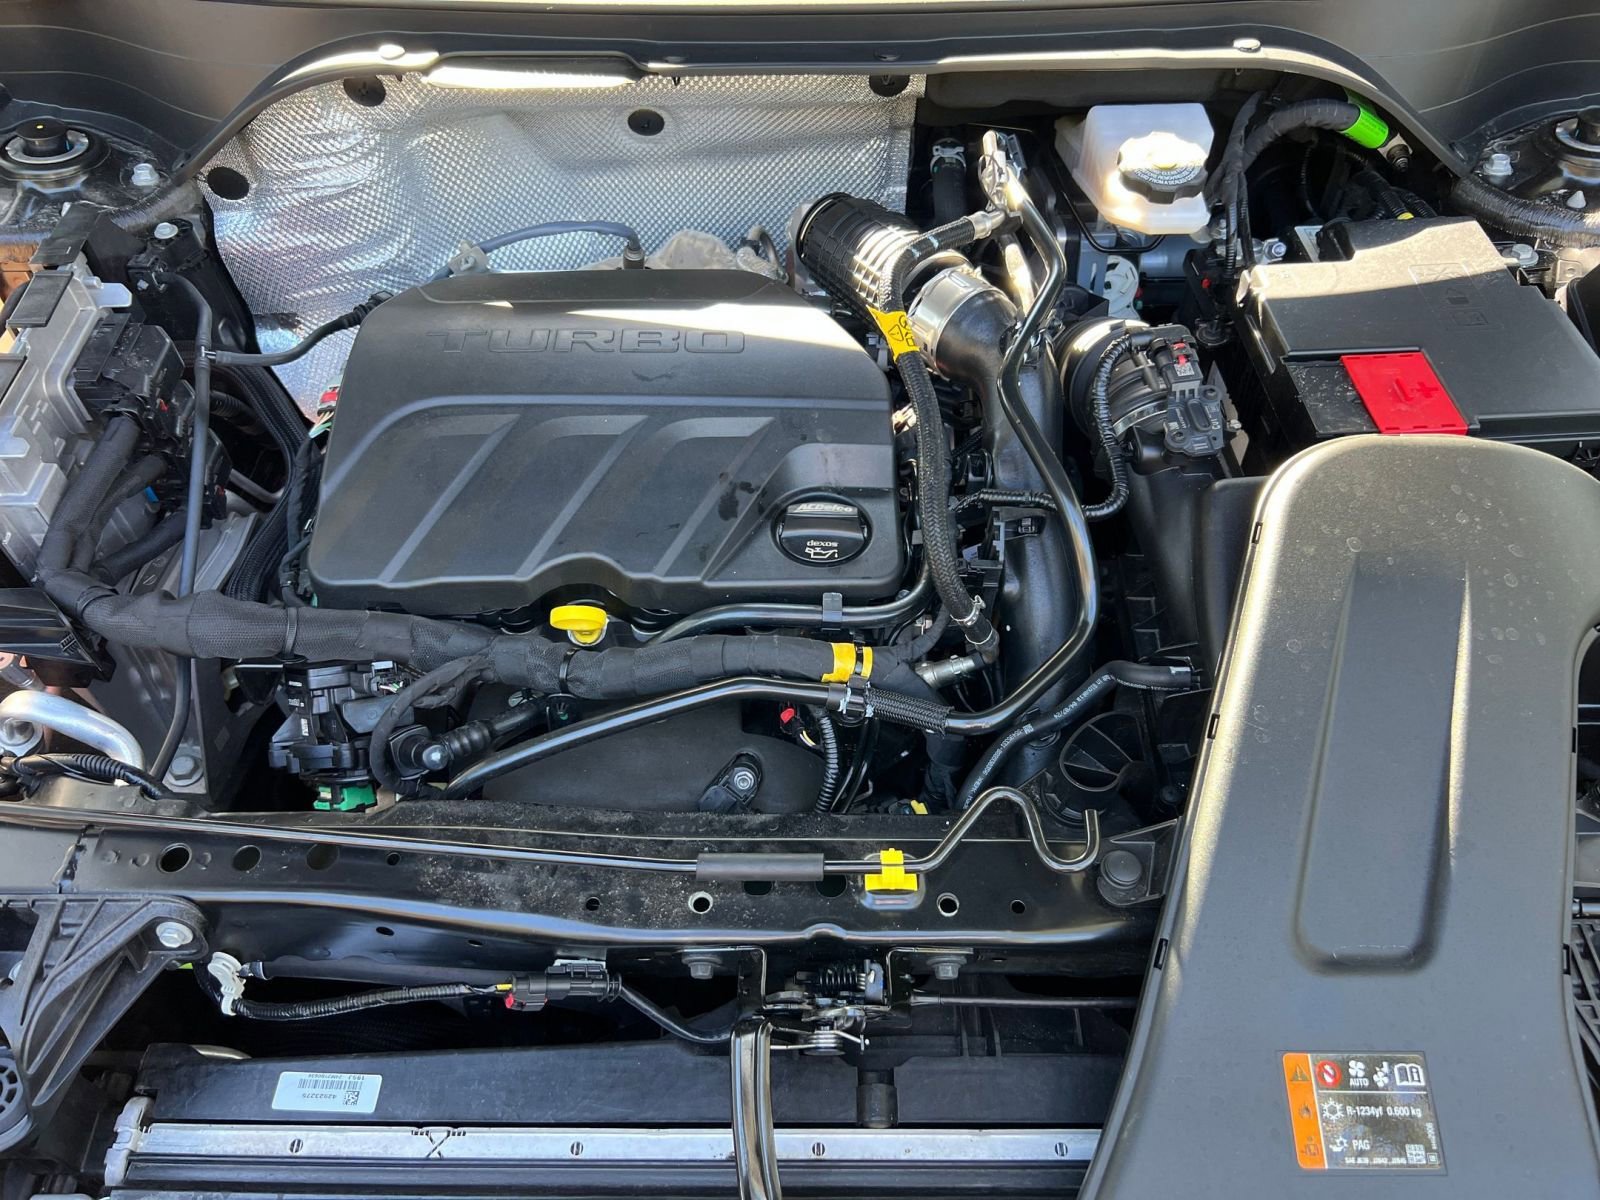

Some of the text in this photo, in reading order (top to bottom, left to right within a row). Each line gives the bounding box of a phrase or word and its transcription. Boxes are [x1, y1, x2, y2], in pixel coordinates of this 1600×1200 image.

[426, 328, 746, 353] TURBO
[806, 540, 839, 548] dexos
[1349, 1078, 1369, 1087] AUTO
[1346, 1106, 1422, 1119] R-1234yf 0.600 kg
[1352, 1140, 1371, 1150] PAG
